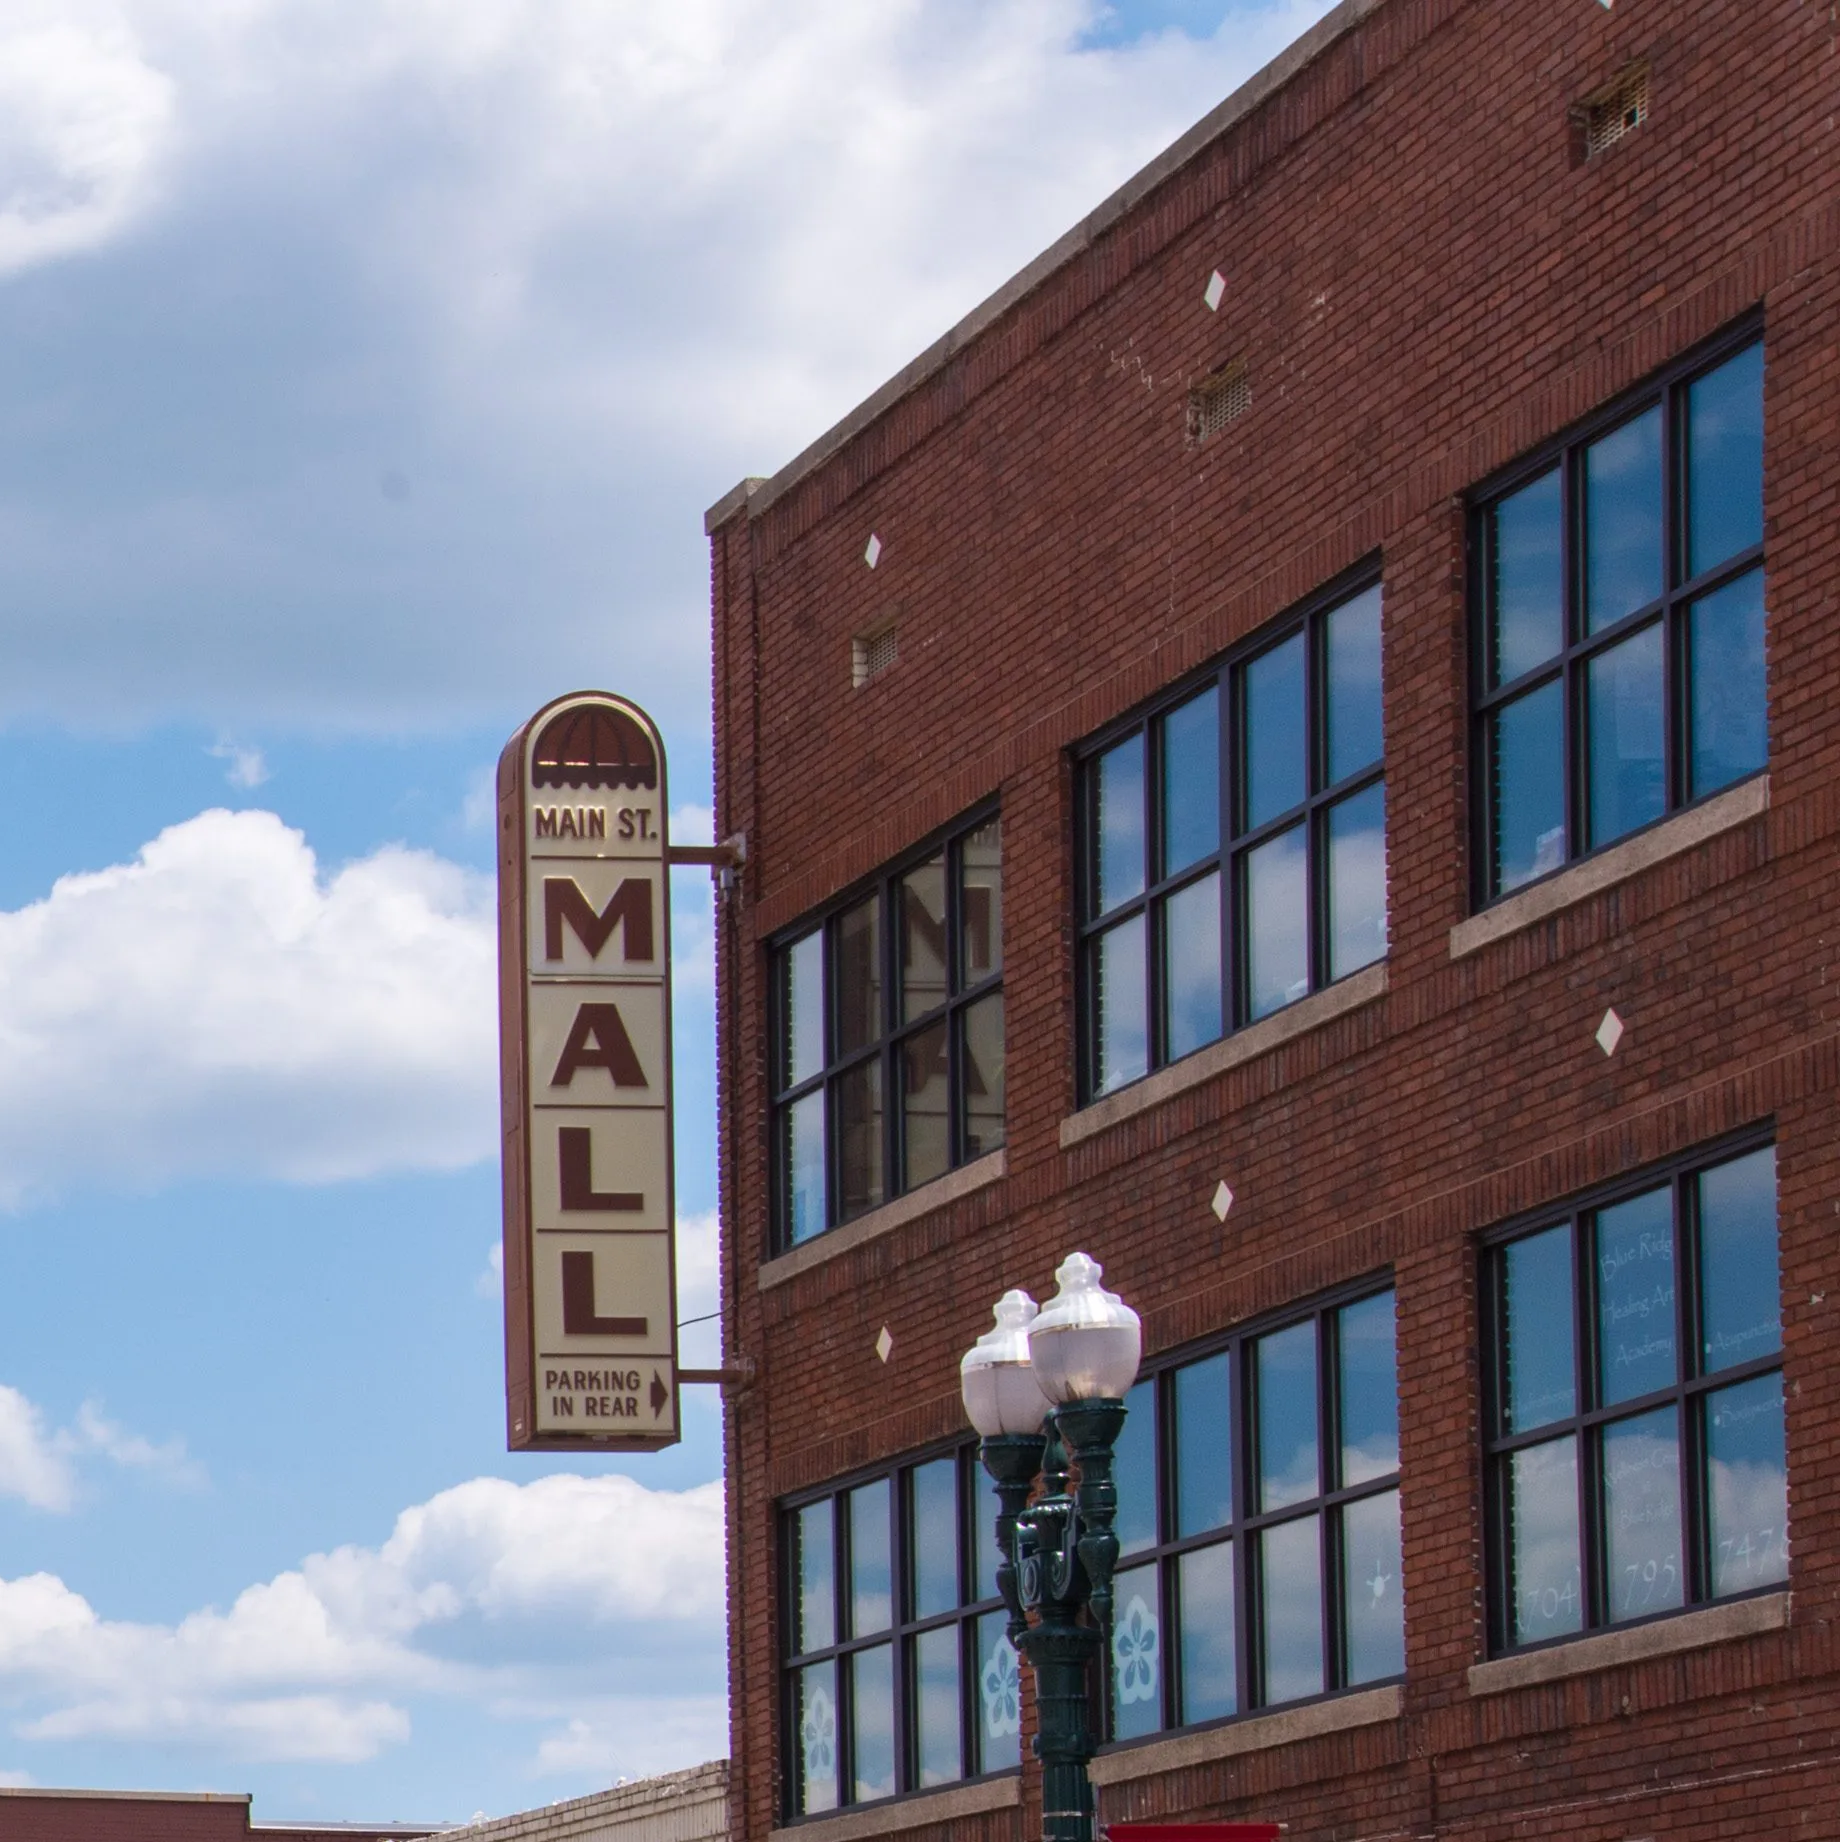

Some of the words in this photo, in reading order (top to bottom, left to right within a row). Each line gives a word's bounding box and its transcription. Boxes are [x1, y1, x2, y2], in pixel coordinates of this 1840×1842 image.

[533, 805, 607, 839] MAIN
[617, 807, 658, 839] ST.
[542, 876, 654, 1337] MALL
[1599, 1244, 1637, 1282] Blue
[1639, 1229, 1673, 1261] Ridg
[545, 1370, 641, 1391] PARKING
[552, 1396, 574, 1417] IN
[585, 1396, 639, 1417] REAR
